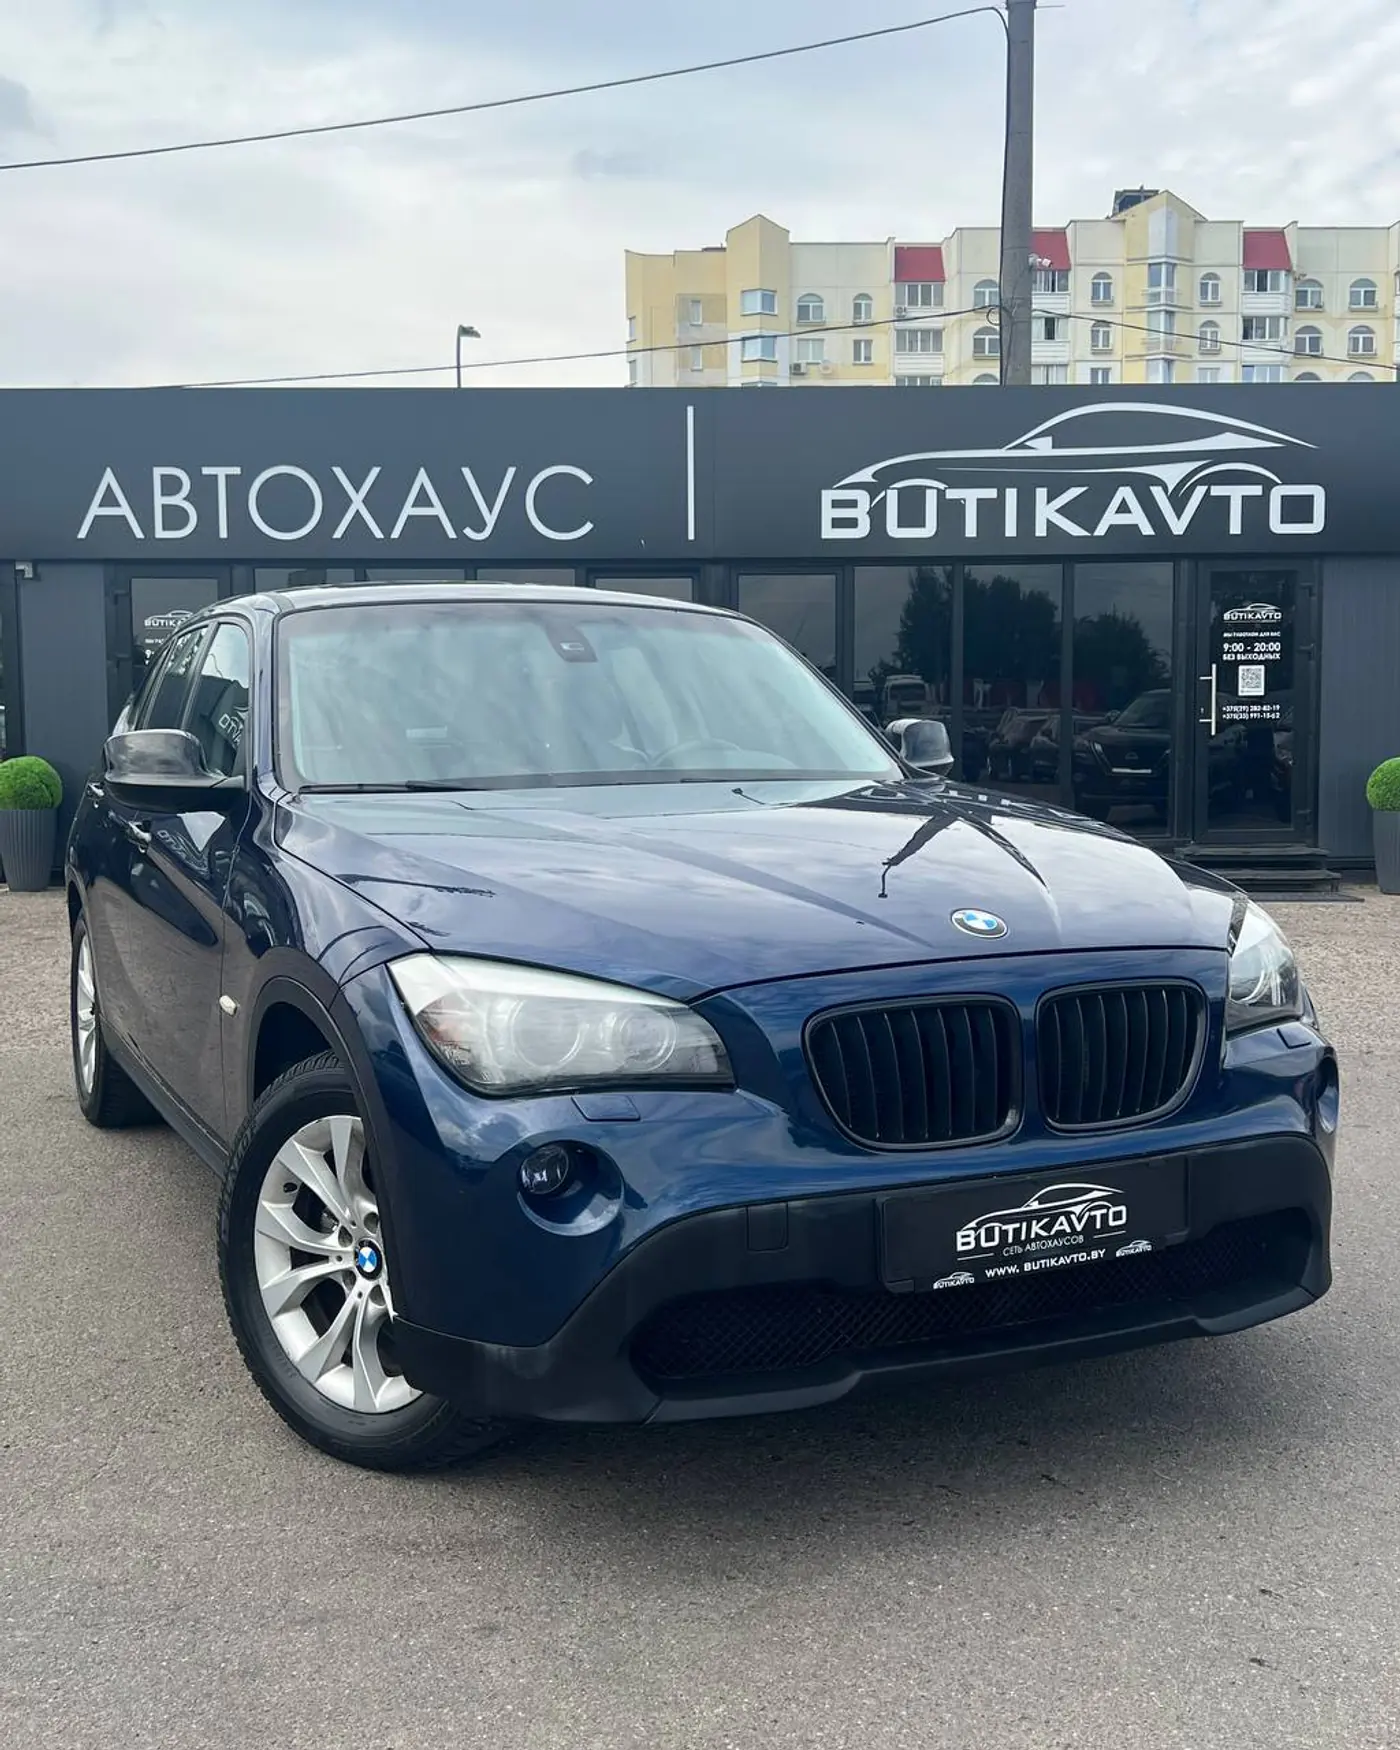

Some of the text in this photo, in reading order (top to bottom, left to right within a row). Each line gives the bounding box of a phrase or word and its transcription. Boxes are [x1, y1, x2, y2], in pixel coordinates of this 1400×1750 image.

[76, 465, 595, 541] АВТОХАУС
[820, 484, 1326, 539] BUTIKAVTO
[1223, 611, 1282, 621] BUTIKAVTO
[1223, 642, 1244, 652] 9:00
[1253, 642, 1281, 652] 20:00
[1236, 652, 1281, 661] ВЫХОДНЫХ
[956, 1205, 1127, 1252] BUTIKAVTO
[1002, 1234, 1084, 1257] СЕТЬ АВТОХАУСОВ
[985, 1248, 1106, 1279] WWW. BUTIKAVTO.BY
